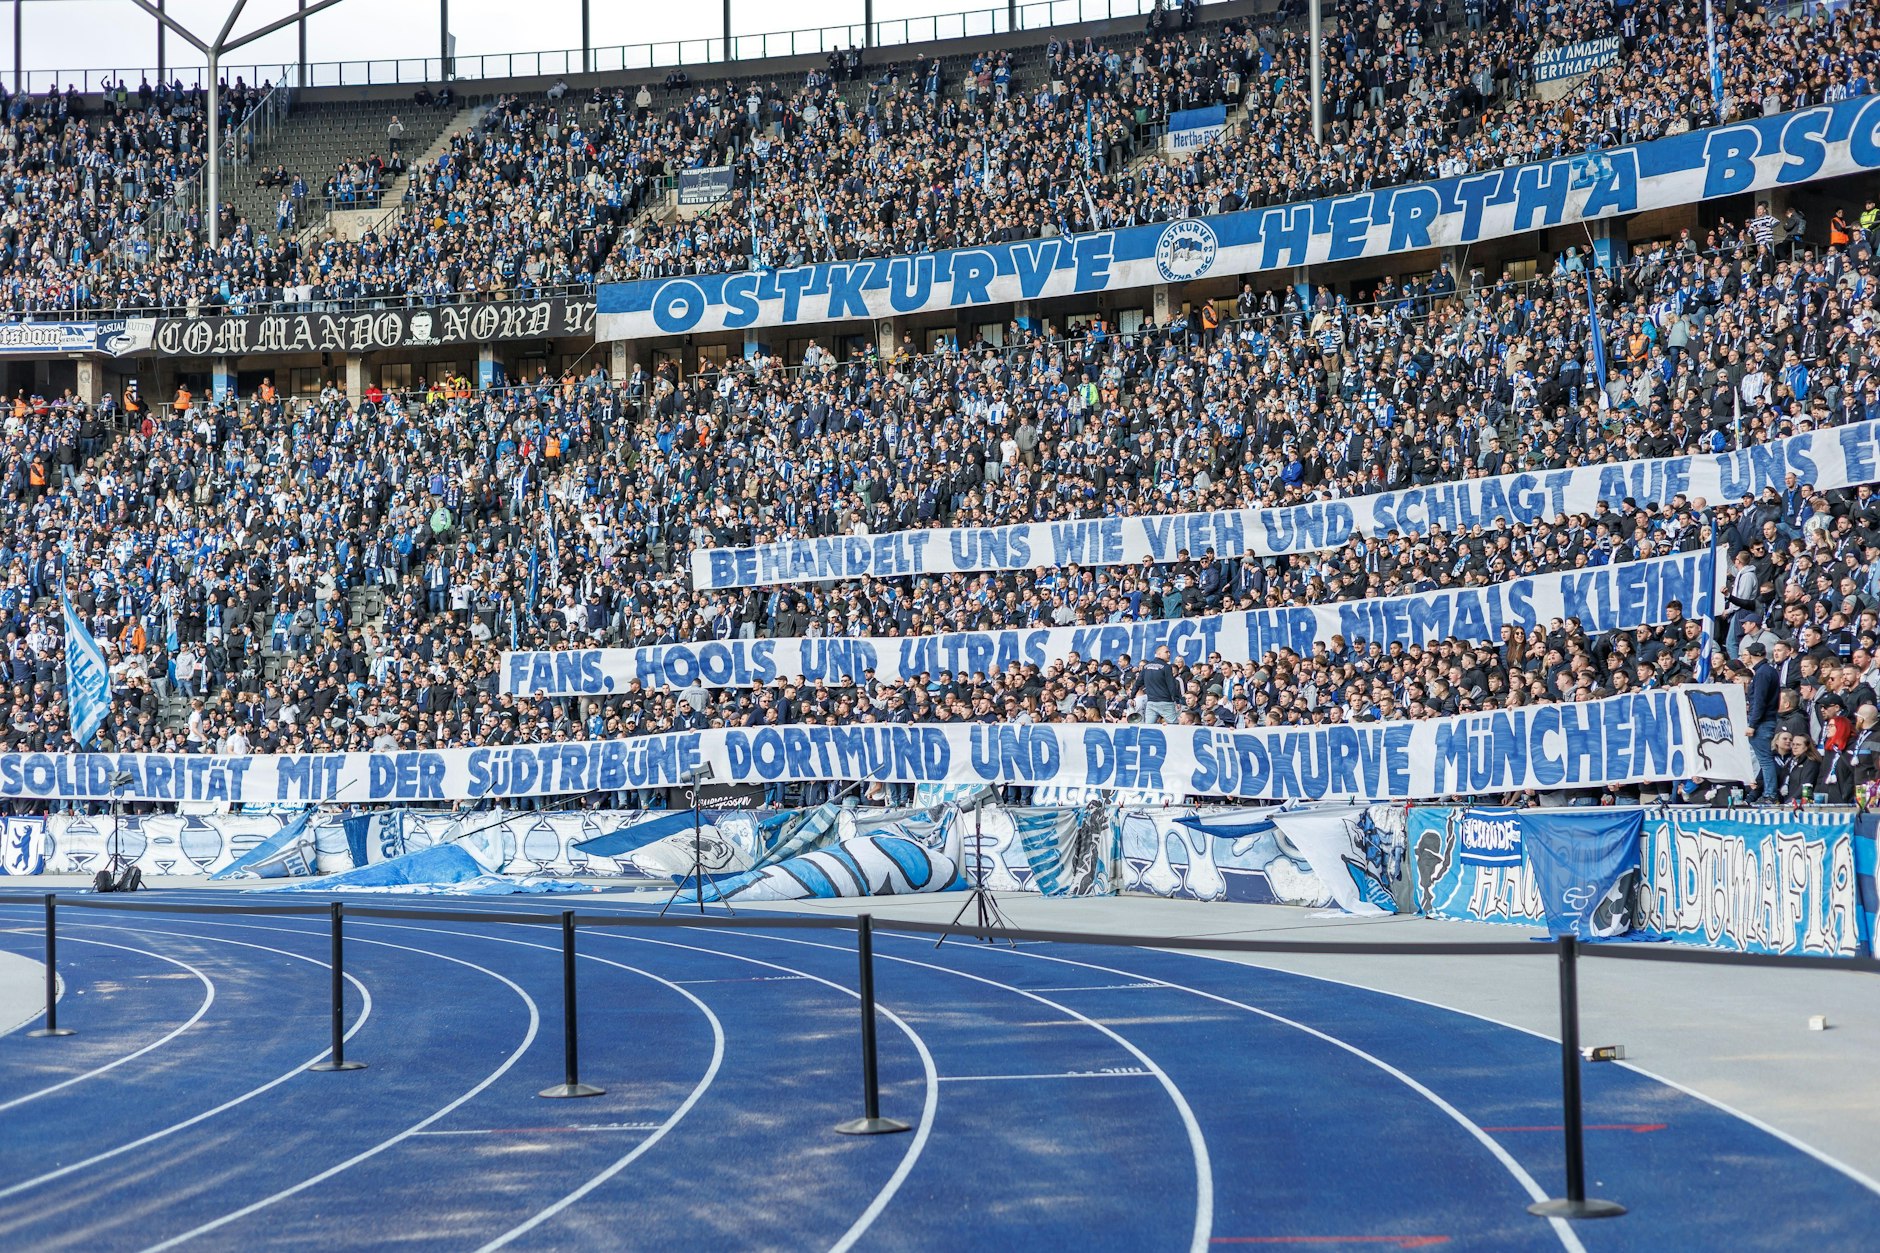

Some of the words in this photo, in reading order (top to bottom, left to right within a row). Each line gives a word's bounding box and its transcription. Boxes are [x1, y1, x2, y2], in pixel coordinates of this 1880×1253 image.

[1533, 46, 1563, 65] SEXY
[1565, 36, 1619, 60] AMAZING
[1173, 131, 1203, 148] Hertha
[682, 196, 708, 204] HERTHA
[357, 215, 374, 227] 34
[652, 233, 1116, 333] OSTKURVE
[1260, 149, 1639, 269] HERTHA
[1163, 223, 1211, 248] OSTKURVE
[1159, 261, 1192, 280] HERTHA
[1195, 256, 1212, 276] BSC
[97, 322, 126, 336] CASUAL
[158, 312, 402, 354] COMMANDO
[442, 302, 551, 342] NORD
[710, 530, 930, 588] BEHANDELT
[949, 524, 1031, 570] UNS
[1052, 517, 1123, 567] WIE
[1145, 510, 1243, 560] VIEH
[1261, 501, 1354, 552] UND
[1373, 471, 1571, 539] SCHLAGT
[1599, 455, 1691, 515] AUF
[1717, 435, 1819, 500] UNS
[1840, 422, 1880, 483] E
[509, 649, 615, 694] FANS,
[635, 639, 777, 686] HOOLS
[802, 636, 878, 682] UND
[899, 629, 1049, 679] ULTRAS
[1072, 615, 1224, 670] KRIEGT
[1246, 607, 1317, 661] IHR
[1338, 579, 1535, 652] NIEMALS
[1, 752, 251, 799] SOLIDARITÄT
[277, 755, 345, 798] MIT
[368, 751, 446, 799] DER
[467, 734, 701, 795] SÜDTRIBÜNE
[725, 725, 951, 781] DORTMUND
[970, 724, 1060, 780] UND
[1084, 726, 1167, 789] DER
[1191, 723, 1411, 800] SÜDKURVE
[1435, 691, 1685, 793] MÜNCHEN!
